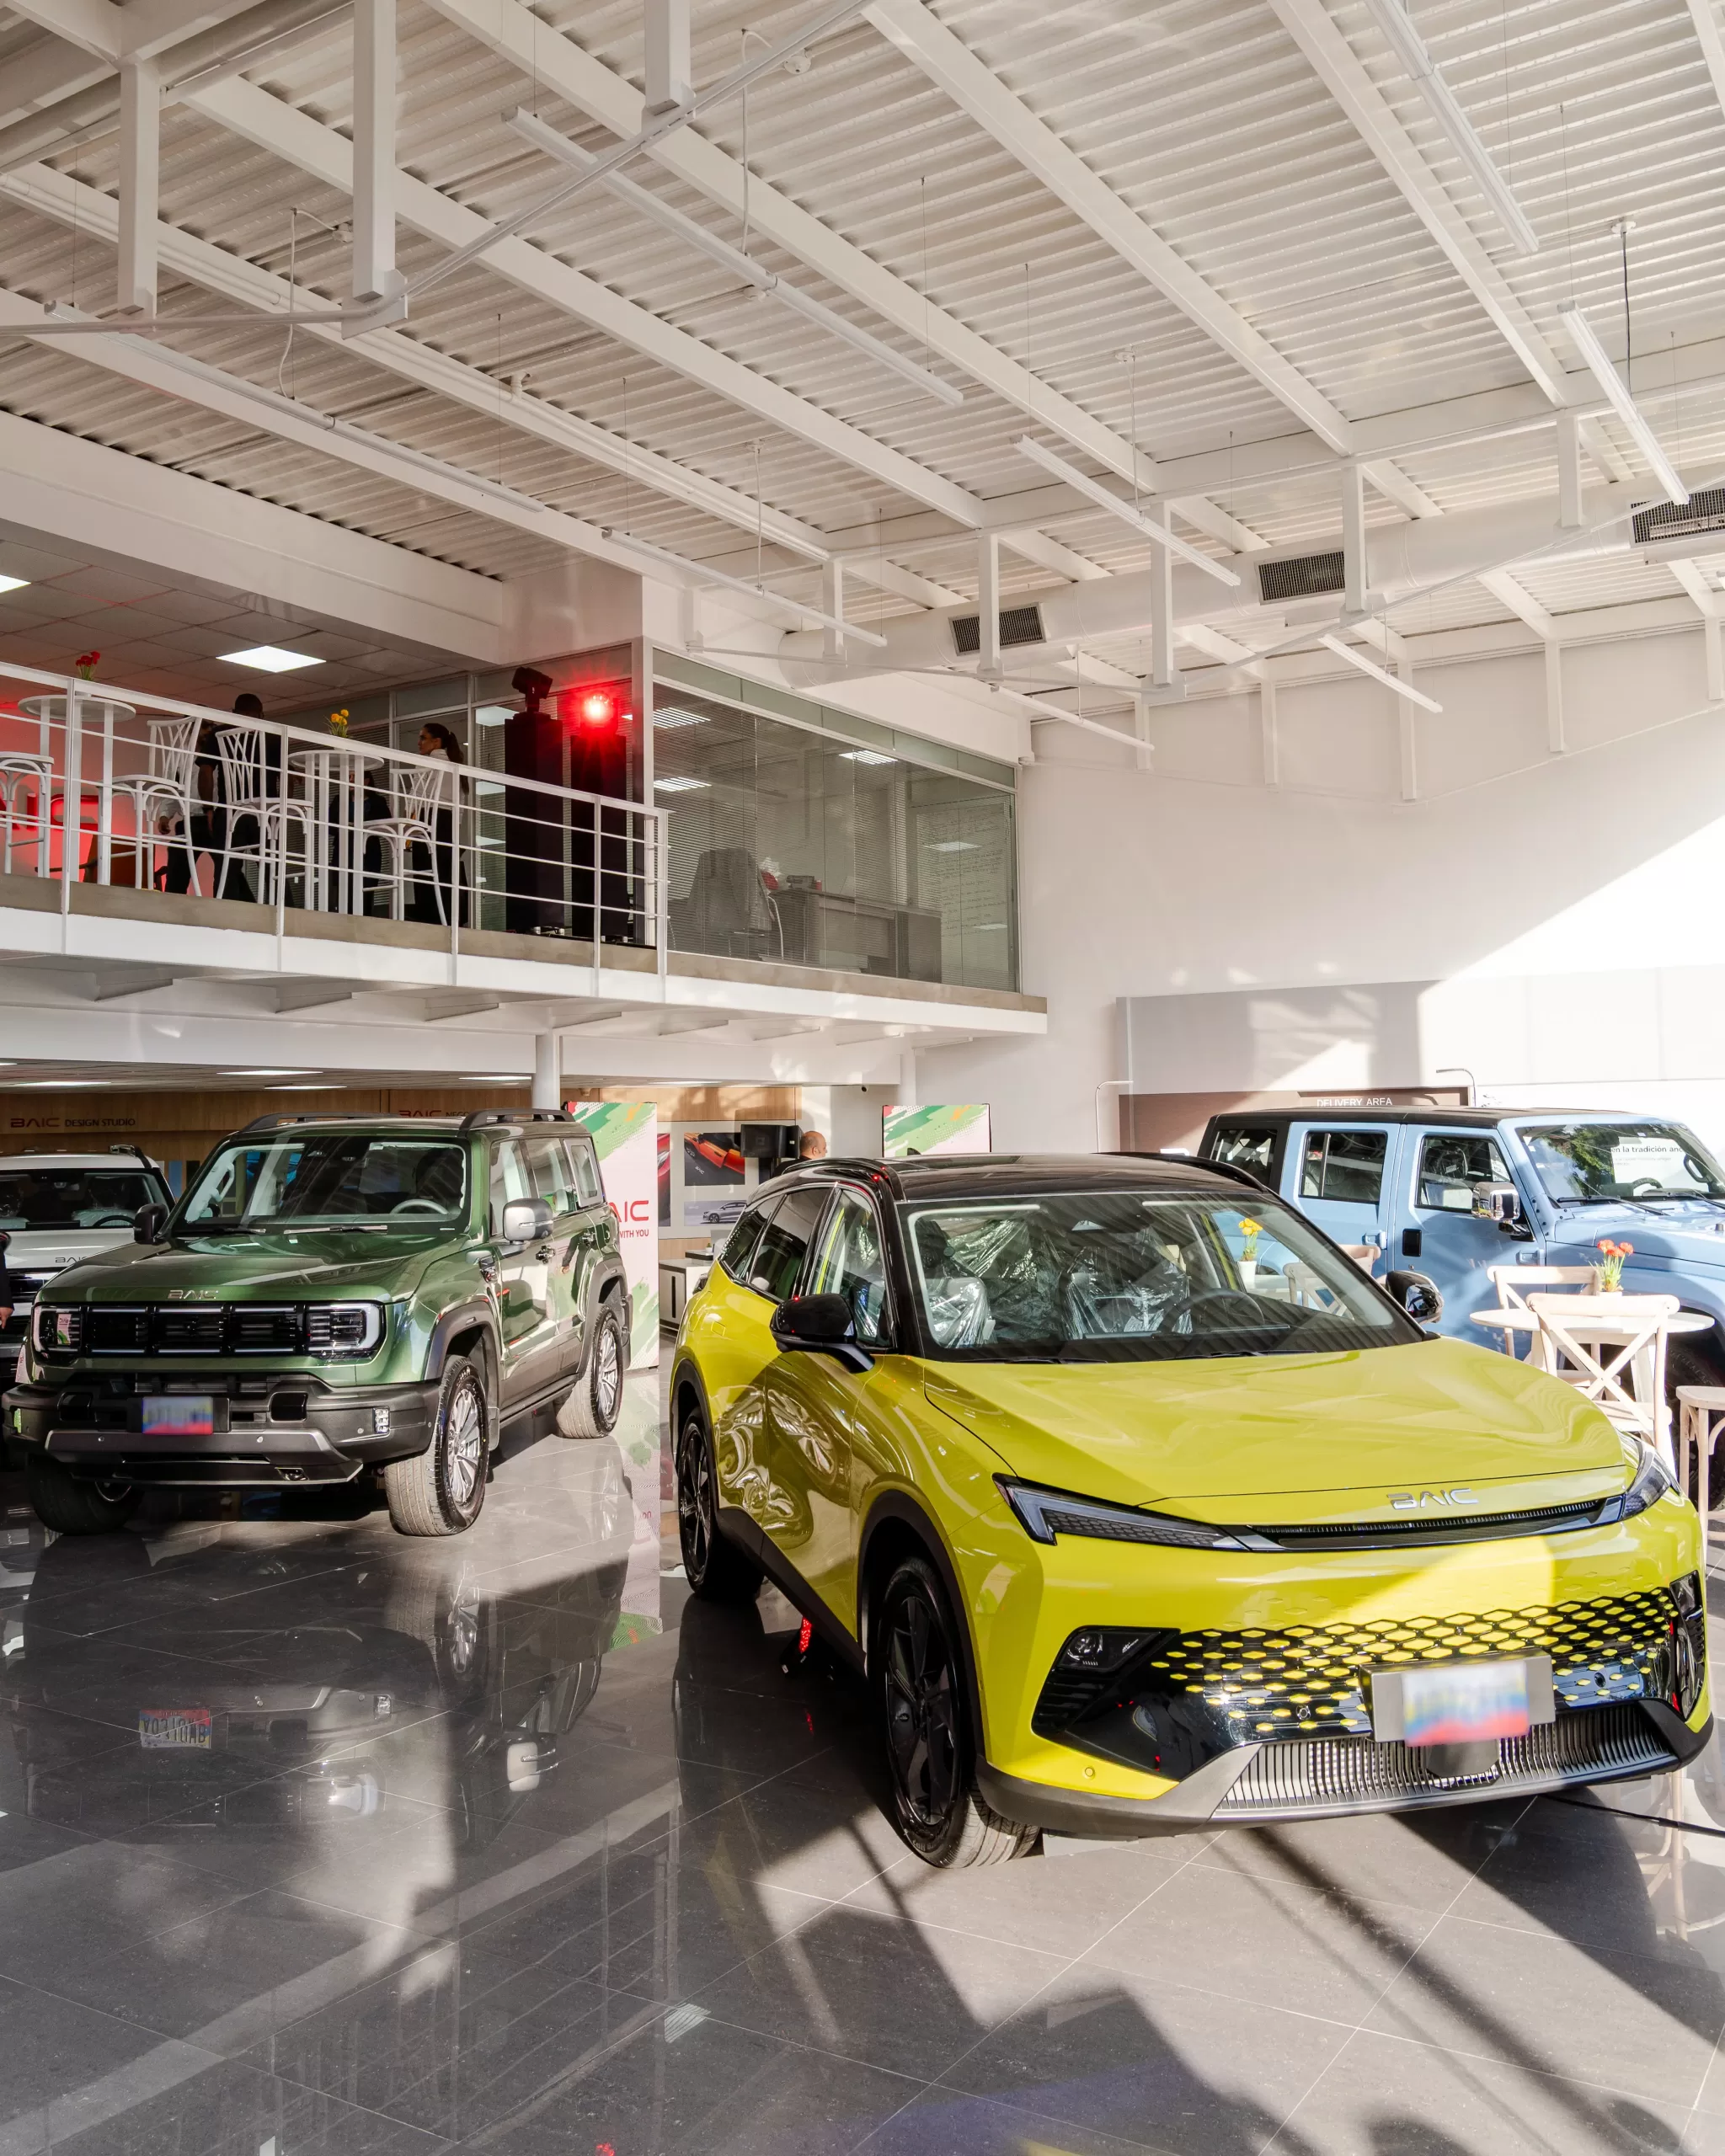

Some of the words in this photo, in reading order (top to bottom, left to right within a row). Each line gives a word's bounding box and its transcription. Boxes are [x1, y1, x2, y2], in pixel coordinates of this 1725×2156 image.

[1316, 1098, 1363, 1107] DELIVERY
[1366, 1097, 1392, 1106] AREA
[10, 1118, 60, 1128] BAIC
[65, 1118, 99, 1127] DESIGN
[608, 1200, 649, 1223] AIC
[635, 1229, 649, 1237] YOU
[168, 1289, 219, 1299] BAIC
[1386, 1487, 1480, 1510] BAIC
